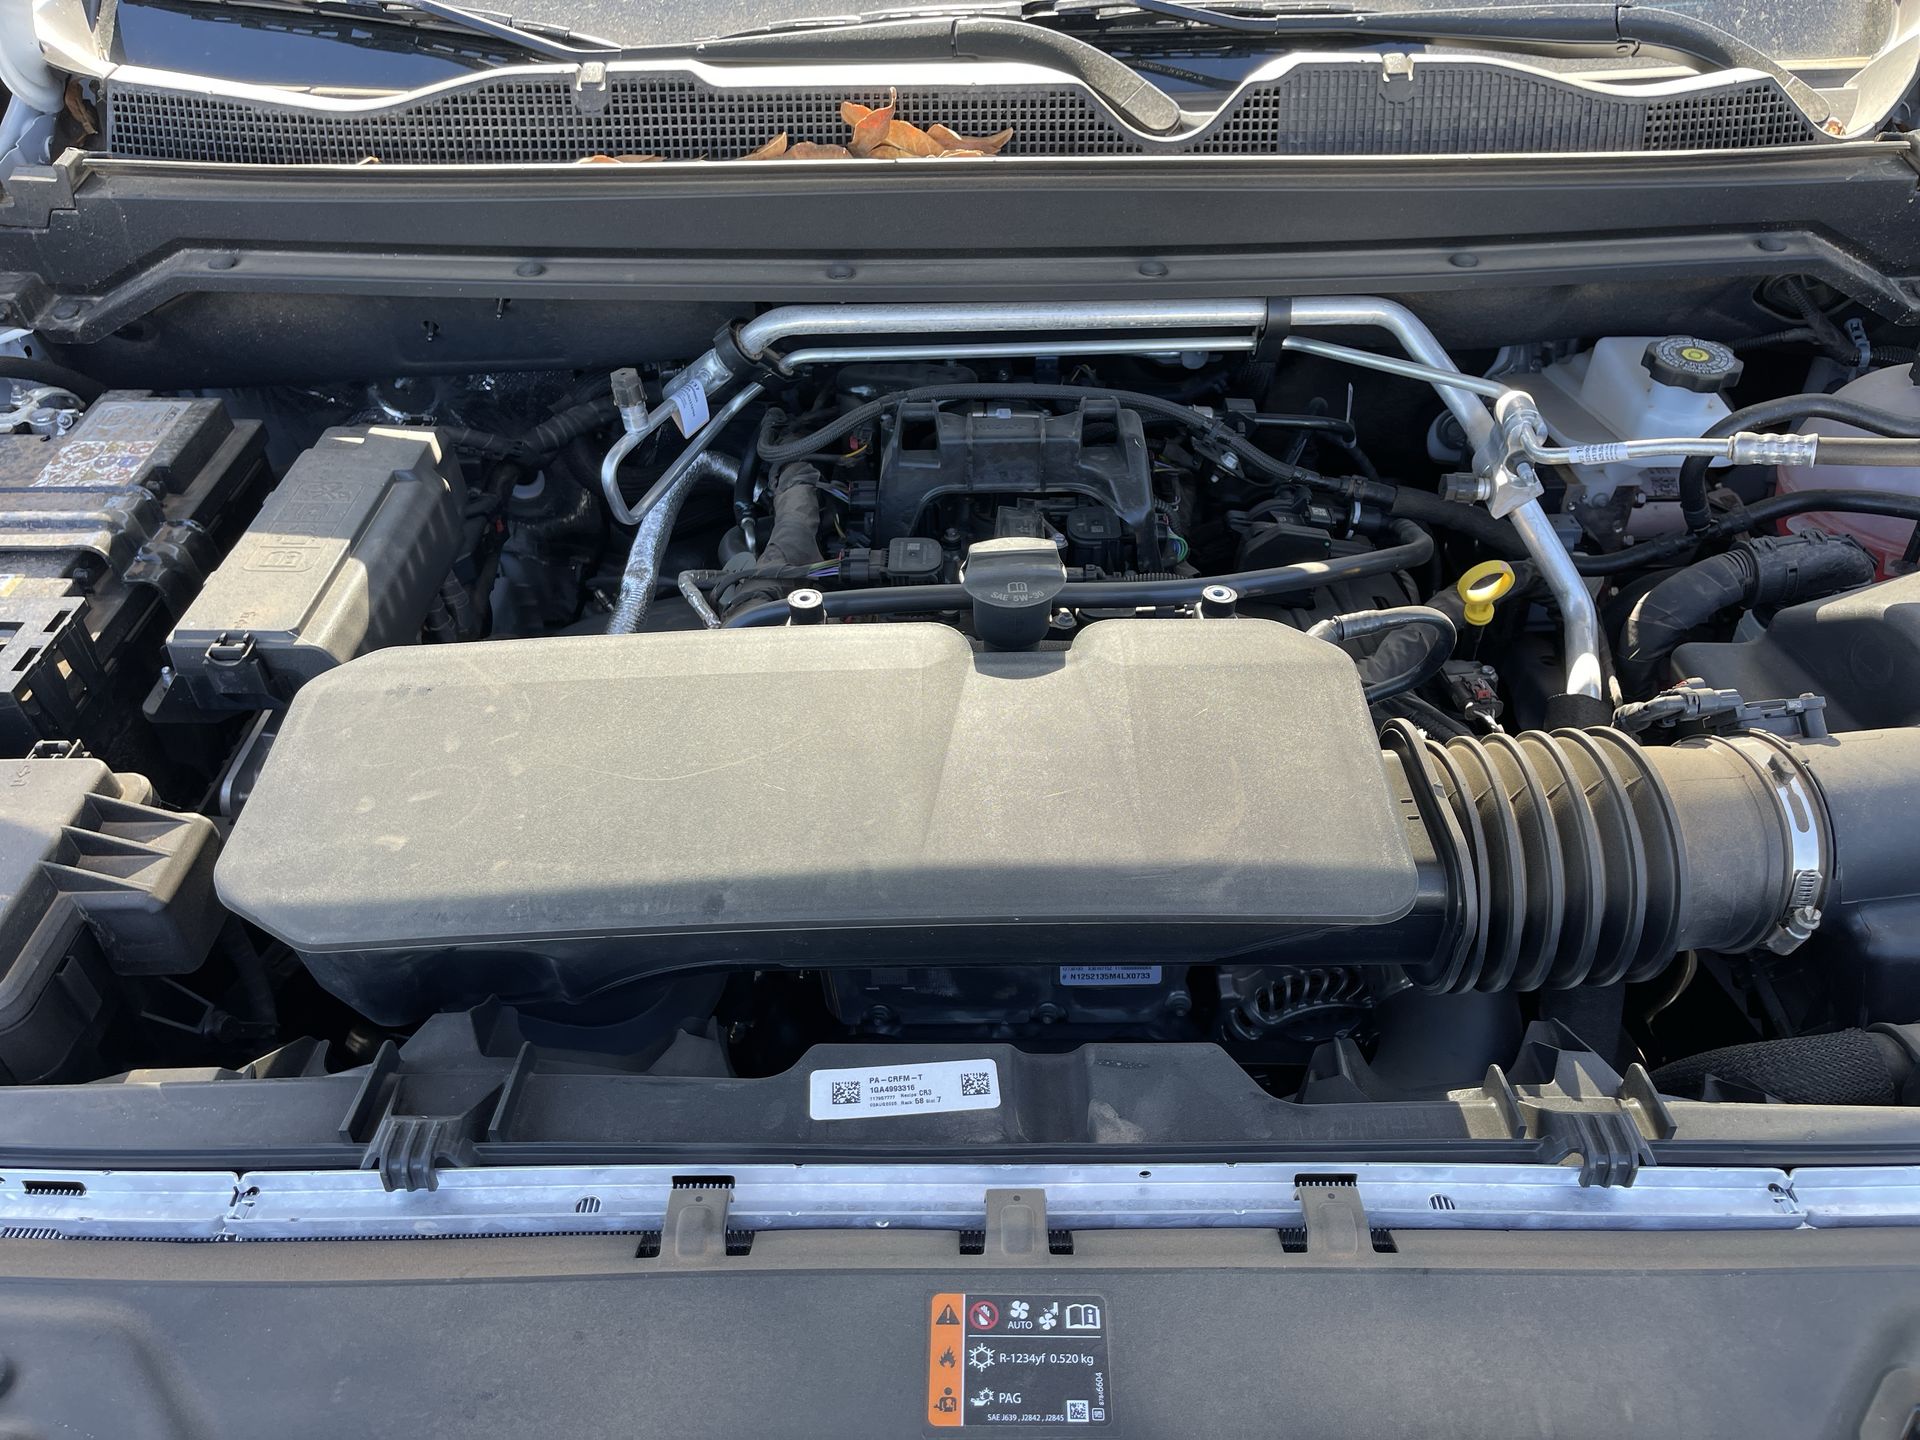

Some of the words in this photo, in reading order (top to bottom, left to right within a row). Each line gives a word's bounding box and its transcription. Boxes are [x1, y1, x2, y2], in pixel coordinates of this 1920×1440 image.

[990, 591, 1009, 601] SAE
[1012, 590, 1045, 602] 5W-30
[936, 1095, 942, 1103] 7
[1007, 1320, 1033, 1330] AUTO
[999, 1352, 1046, 1366] R-1234yf
[1050, 1353, 1079, 1364] 0.520
[1081, 1353, 1094, 1367] kg
[999, 1392, 1022, 1404] PAG
[987, 1413, 1001, 1421] SAE
[1045, 1414, 1065, 1422] J2845
